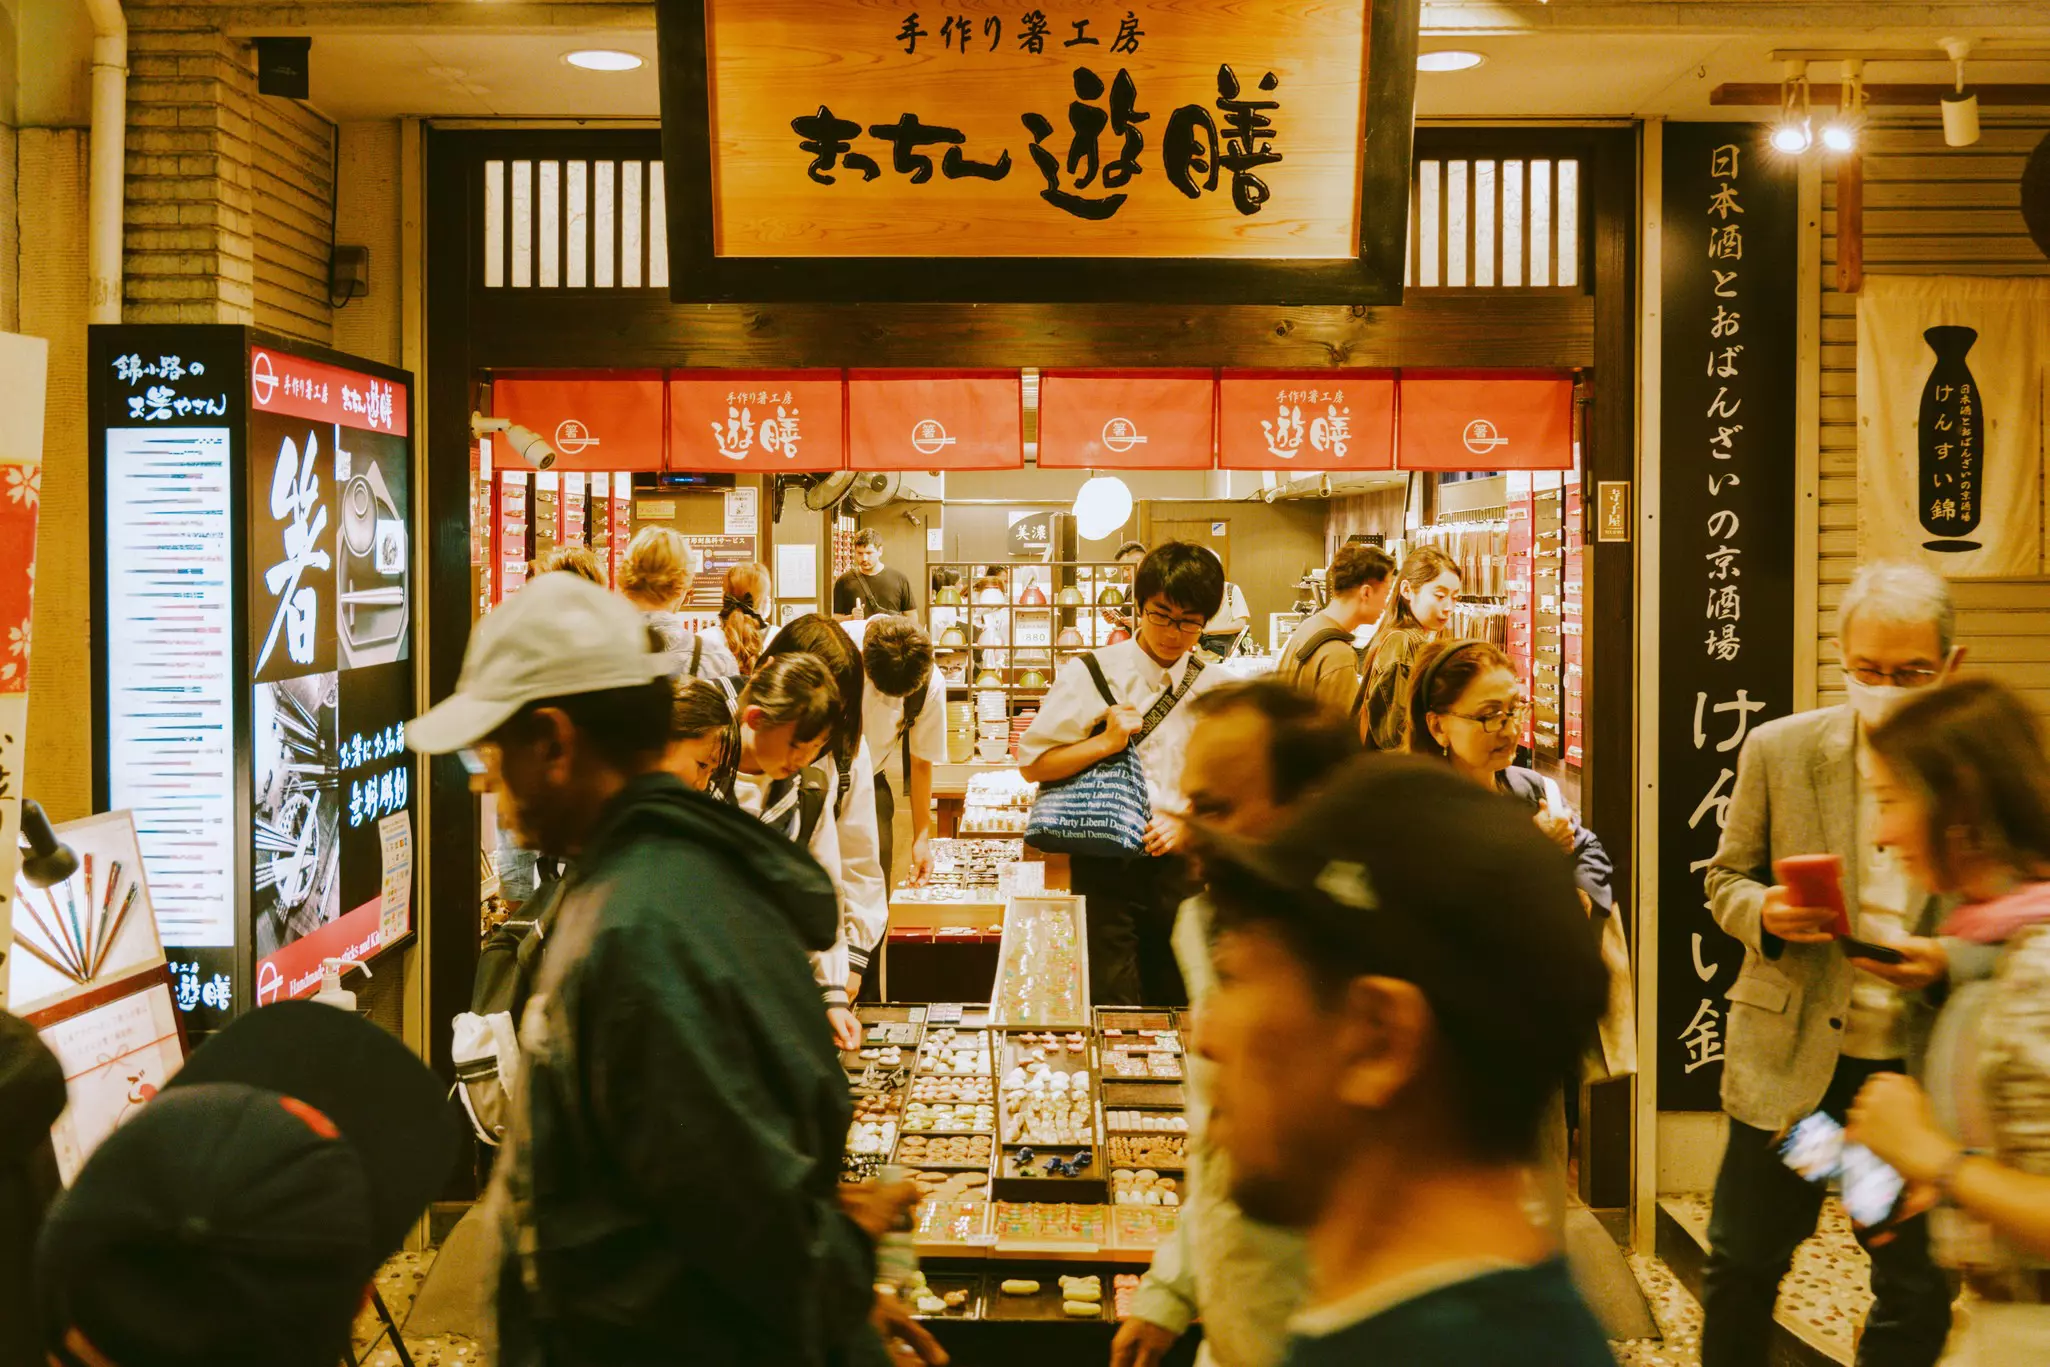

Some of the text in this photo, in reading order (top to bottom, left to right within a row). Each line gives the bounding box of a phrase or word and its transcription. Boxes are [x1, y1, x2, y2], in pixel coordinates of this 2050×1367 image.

[895, 11, 1146, 55] 手作り箸工房
[111, 353, 206, 387] 錦小路の
[127, 385, 228, 422] お箸やさん
[283, 373, 329, 405] 手作り箸工房
[725, 390, 794, 405] 手作り箸工房
[1275, 389, 1345, 404] 手作り箸工房
[1704, 143, 1745, 662] 日本酒とおばんざいの京酒場
[711, 406, 802, 460] 遊膳
[1260, 404, 1353, 460] 遊膳
[1929, 383, 1956, 522] けんすい錦
[1059, 817, 1079, 828] Party
[1080, 817, 1109, 828] Liberal
[1062, 829, 1087, 839] Liberal
